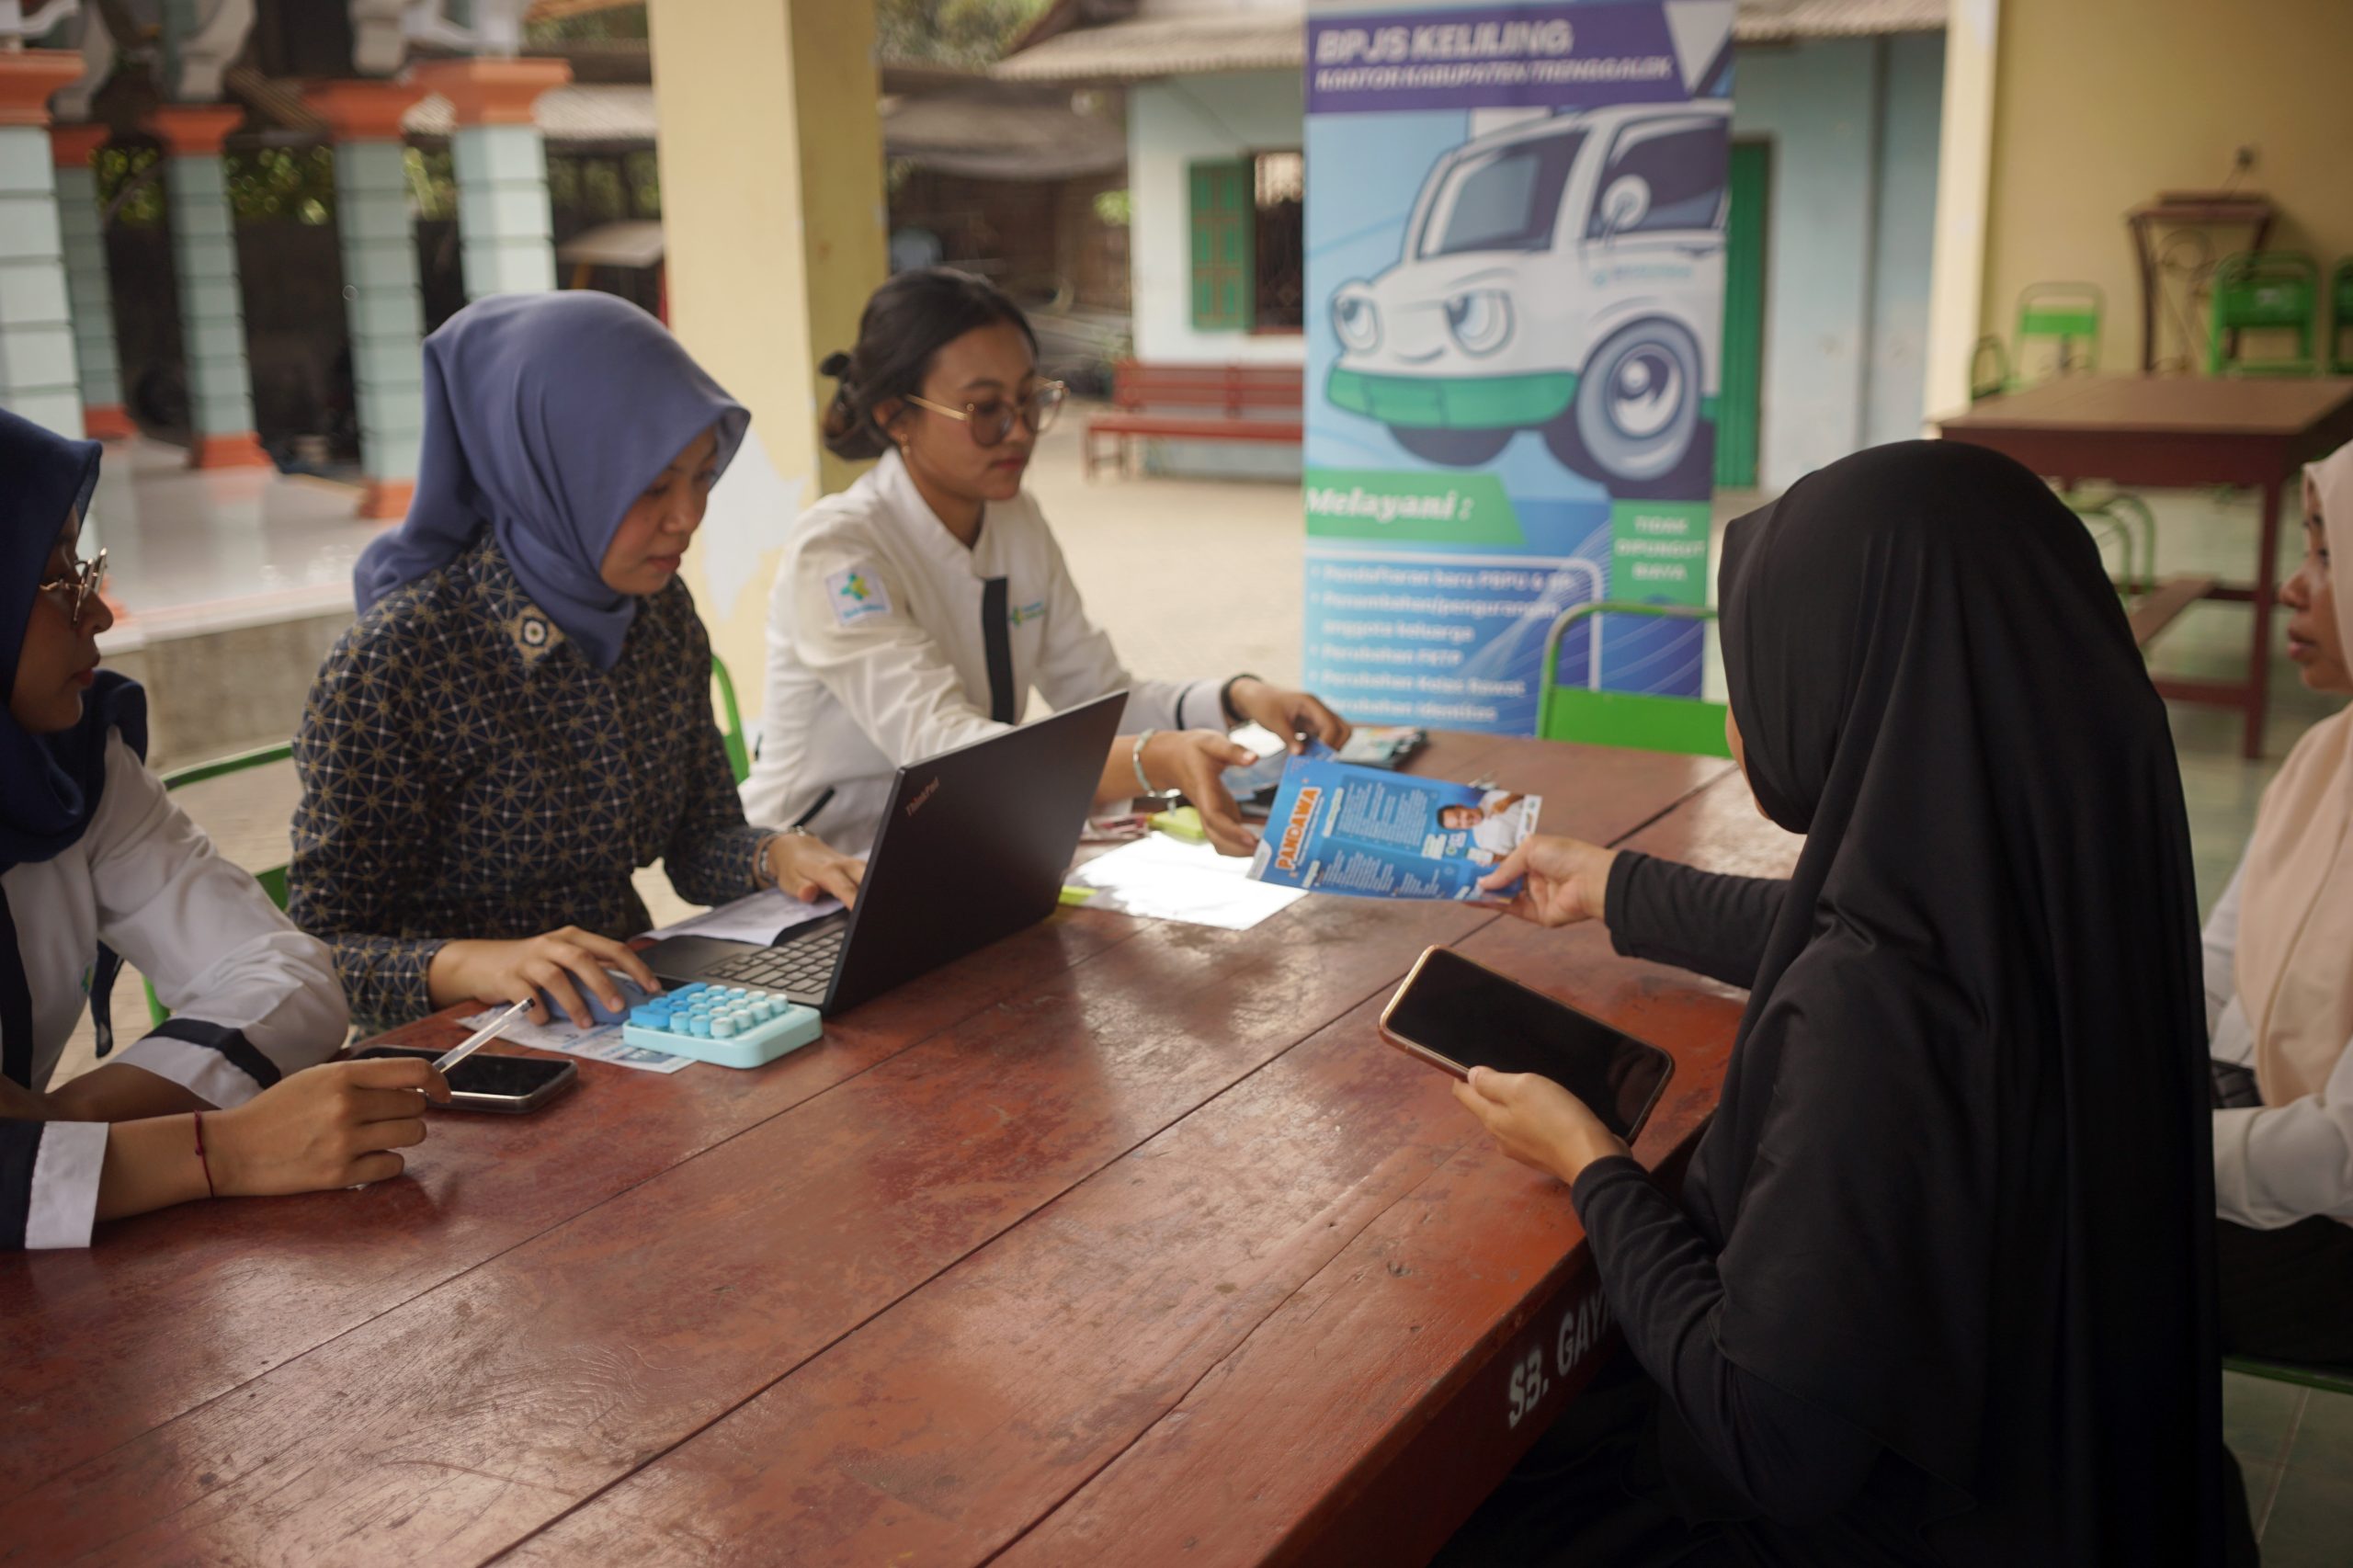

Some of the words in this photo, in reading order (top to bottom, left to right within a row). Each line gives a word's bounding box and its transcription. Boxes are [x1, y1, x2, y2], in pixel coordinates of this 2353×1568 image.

[1315, 26, 1408, 63] BPJS
[1413, 19, 1574, 59] KELILING
[1306, 486, 1458, 523] Melayani
[1634, 516, 1689, 534] TIDAK
[1616, 539, 1706, 557] DIPUNGUT
[1323, 564, 1430, 586] Pendaftaran
[1433, 568, 1474, 588] baru
[1631, 562, 1688, 581] BIAYA
[1322, 643, 1413, 665] Perubahan
[1321, 668, 1413, 689] Perubahan
[1275, 787, 1322, 870] PANDAWA
